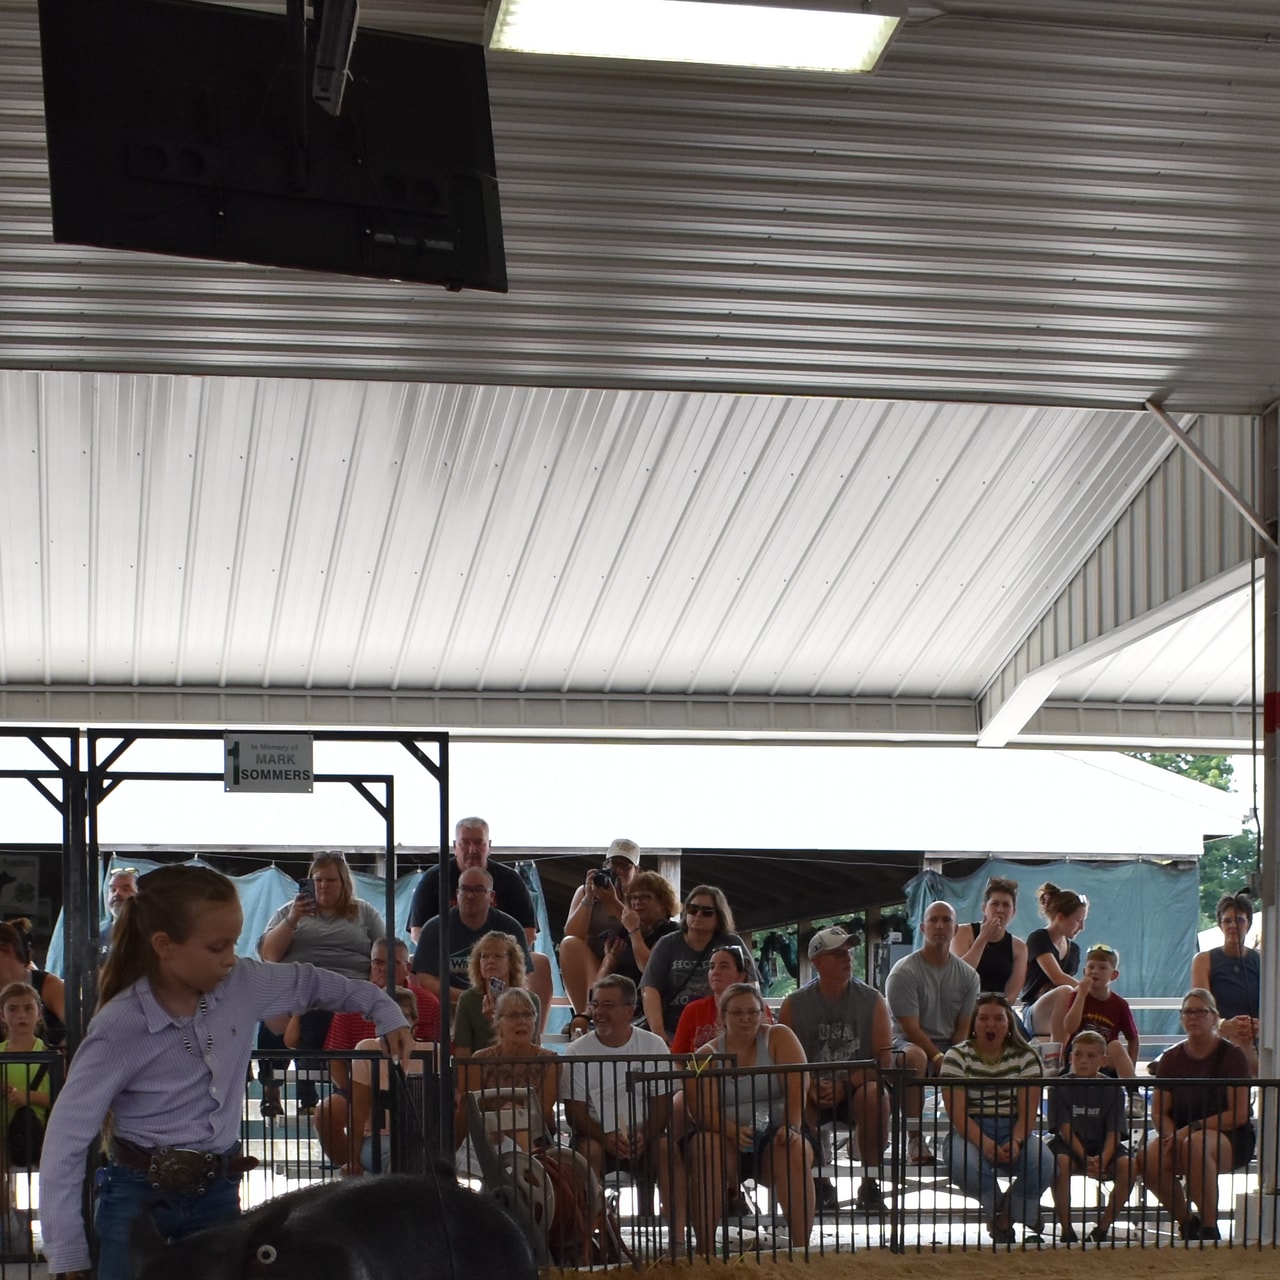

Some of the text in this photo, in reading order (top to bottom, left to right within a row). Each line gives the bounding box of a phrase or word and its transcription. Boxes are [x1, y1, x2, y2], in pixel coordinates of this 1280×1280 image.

[227, 741, 240, 785] 1
[256, 754, 296, 765] MARK
[240, 769, 311, 780] SOMMERS
